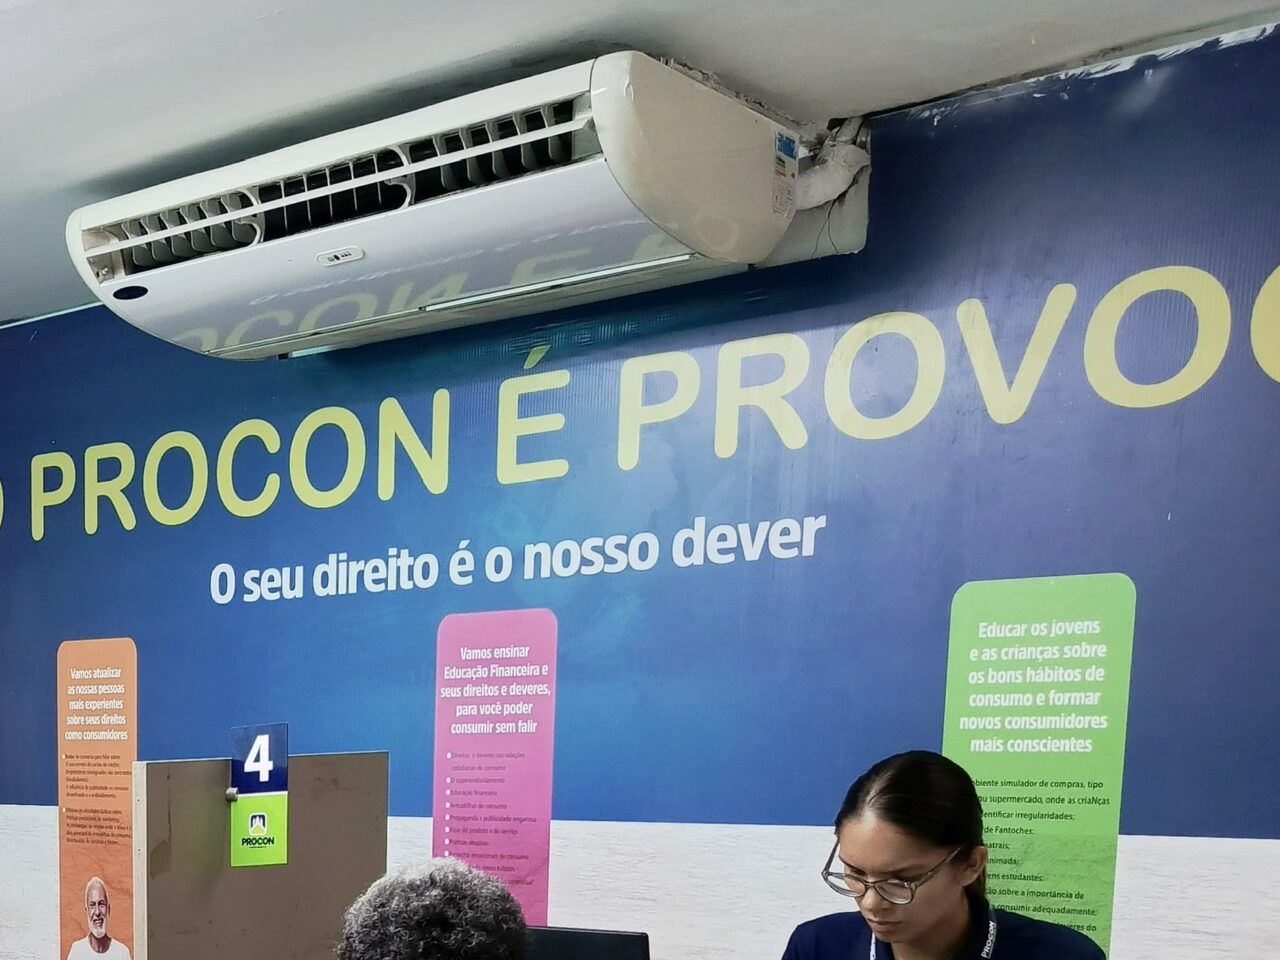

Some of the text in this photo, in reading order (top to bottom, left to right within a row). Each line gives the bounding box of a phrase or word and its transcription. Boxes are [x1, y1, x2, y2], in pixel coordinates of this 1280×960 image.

[31, 388, 451, 542] PROCON
[496, 345, 570, 485] É
[617, 262, 1280, 470] PROVO
[210, 513, 827, 605] O seu direito é o nosso dever
[978, 619, 1101, 638] Educar os jovens
[460, 644, 531, 661] Vamos ensinar
[969, 642, 1108, 662] e as crianças sobre
[443, 662, 549, 681] Educação Financeira e
[968, 664, 1106, 684] os bons hábitos de
[439, 682, 551, 699] seus direitos e deveres,
[968, 689, 1102, 707] consumo e formar
[455, 700, 534, 718] para você poder
[450, 719, 538, 735] consumir sem falir
[959, 713, 1109, 730] novos consumidores
[970, 736, 1094, 753] mais conscientes
[243, 734, 274, 782] 4
[1000, 779, 1104, 790] simulador de compras, tipo
[241, 837, 275, 847] PROCON
